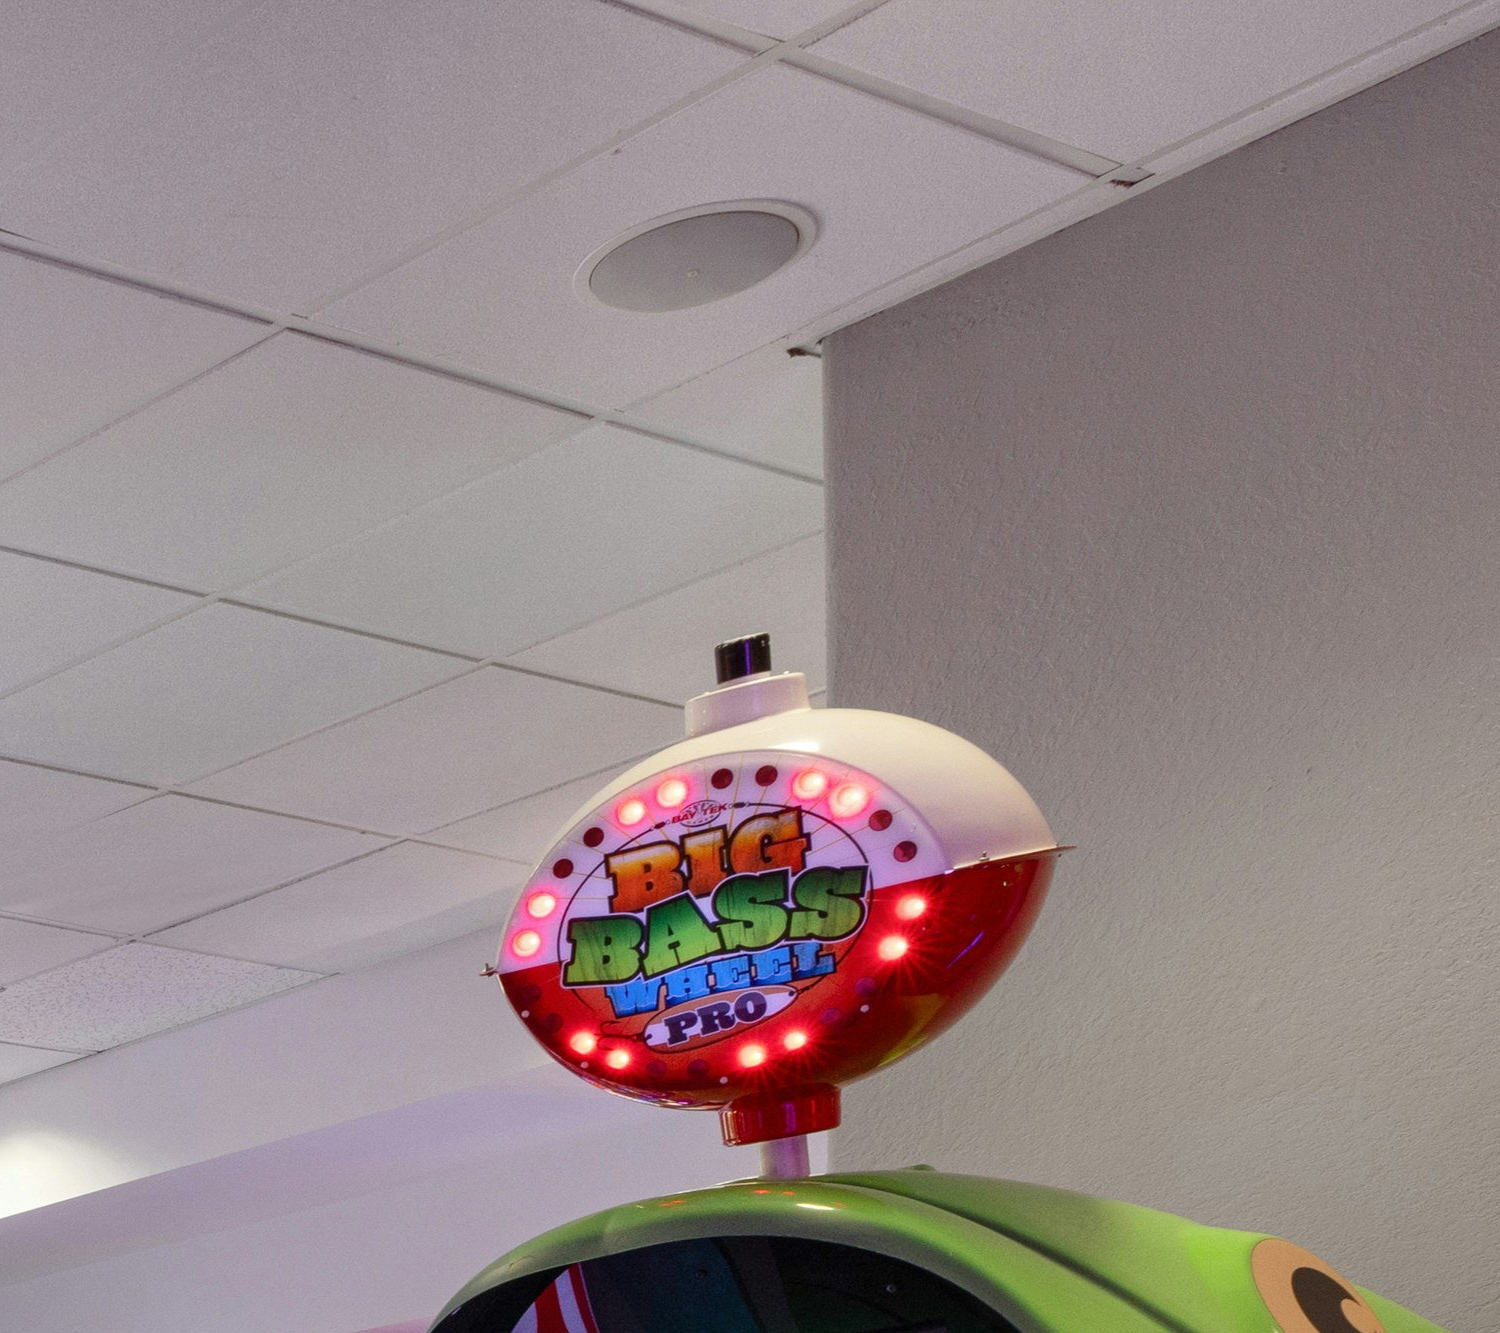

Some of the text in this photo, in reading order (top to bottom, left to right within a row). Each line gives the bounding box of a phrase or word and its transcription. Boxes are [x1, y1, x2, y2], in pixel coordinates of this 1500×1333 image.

[671, 802, 729, 825] BAY TEK
[605, 805, 812, 914] BIG
[561, 865, 869, 986] BASS
[603, 942, 836, 1019] WHEEL
[664, 991, 769, 1048] PRO
